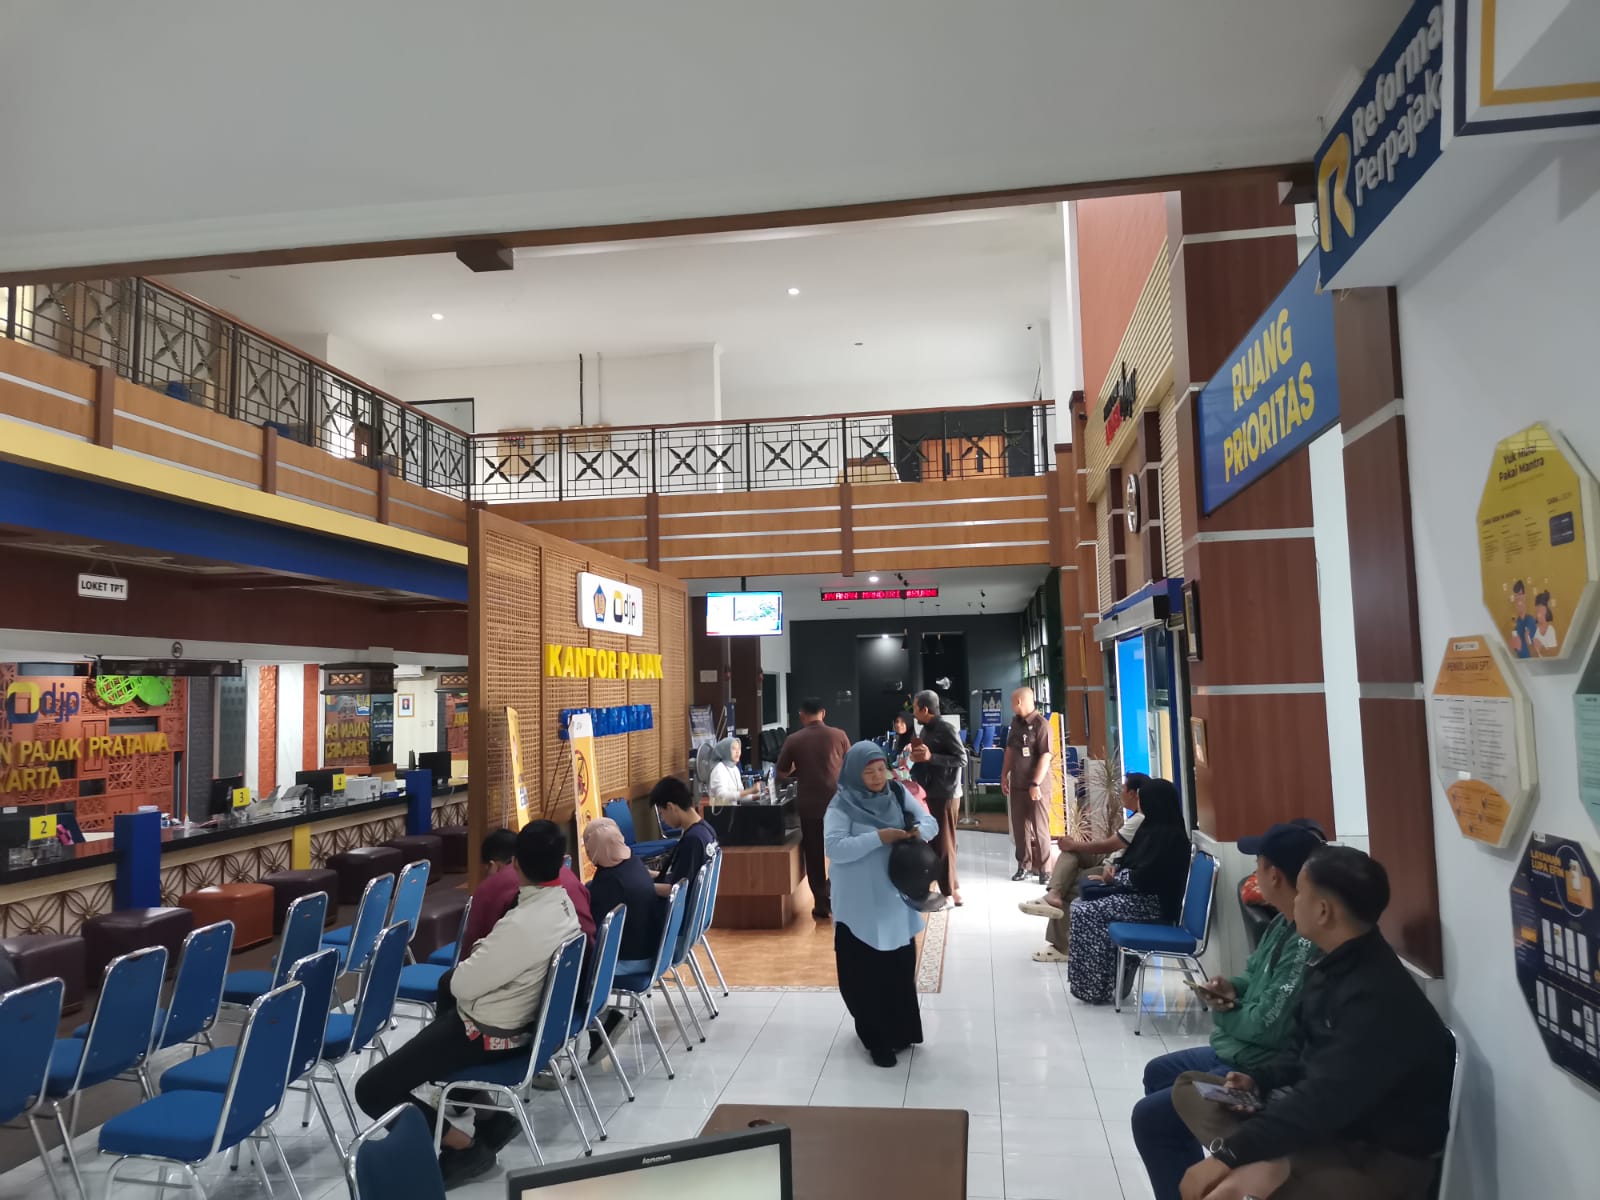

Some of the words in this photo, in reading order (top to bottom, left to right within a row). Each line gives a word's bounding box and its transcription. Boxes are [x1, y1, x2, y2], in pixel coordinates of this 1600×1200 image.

[1352, 5, 1443, 156] Reforma
[1355, 64, 1444, 206] Perpajak
[1231, 308, 1293, 412] RUANG
[1223, 361, 1315, 483] PRIORITAS
[81, 580, 107, 592] LOKET
[110, 583, 124, 593] TPT
[545, 643, 617, 680] KANTOR
[618, 651, 664, 680] PAJAK
[40, 682, 81, 723] djp
[19, 737, 82, 764] PAJAK
[89, 732, 170, 759] PRATAMA
[239, 791, 244, 804] 3
[40, 820, 48, 835] 2
